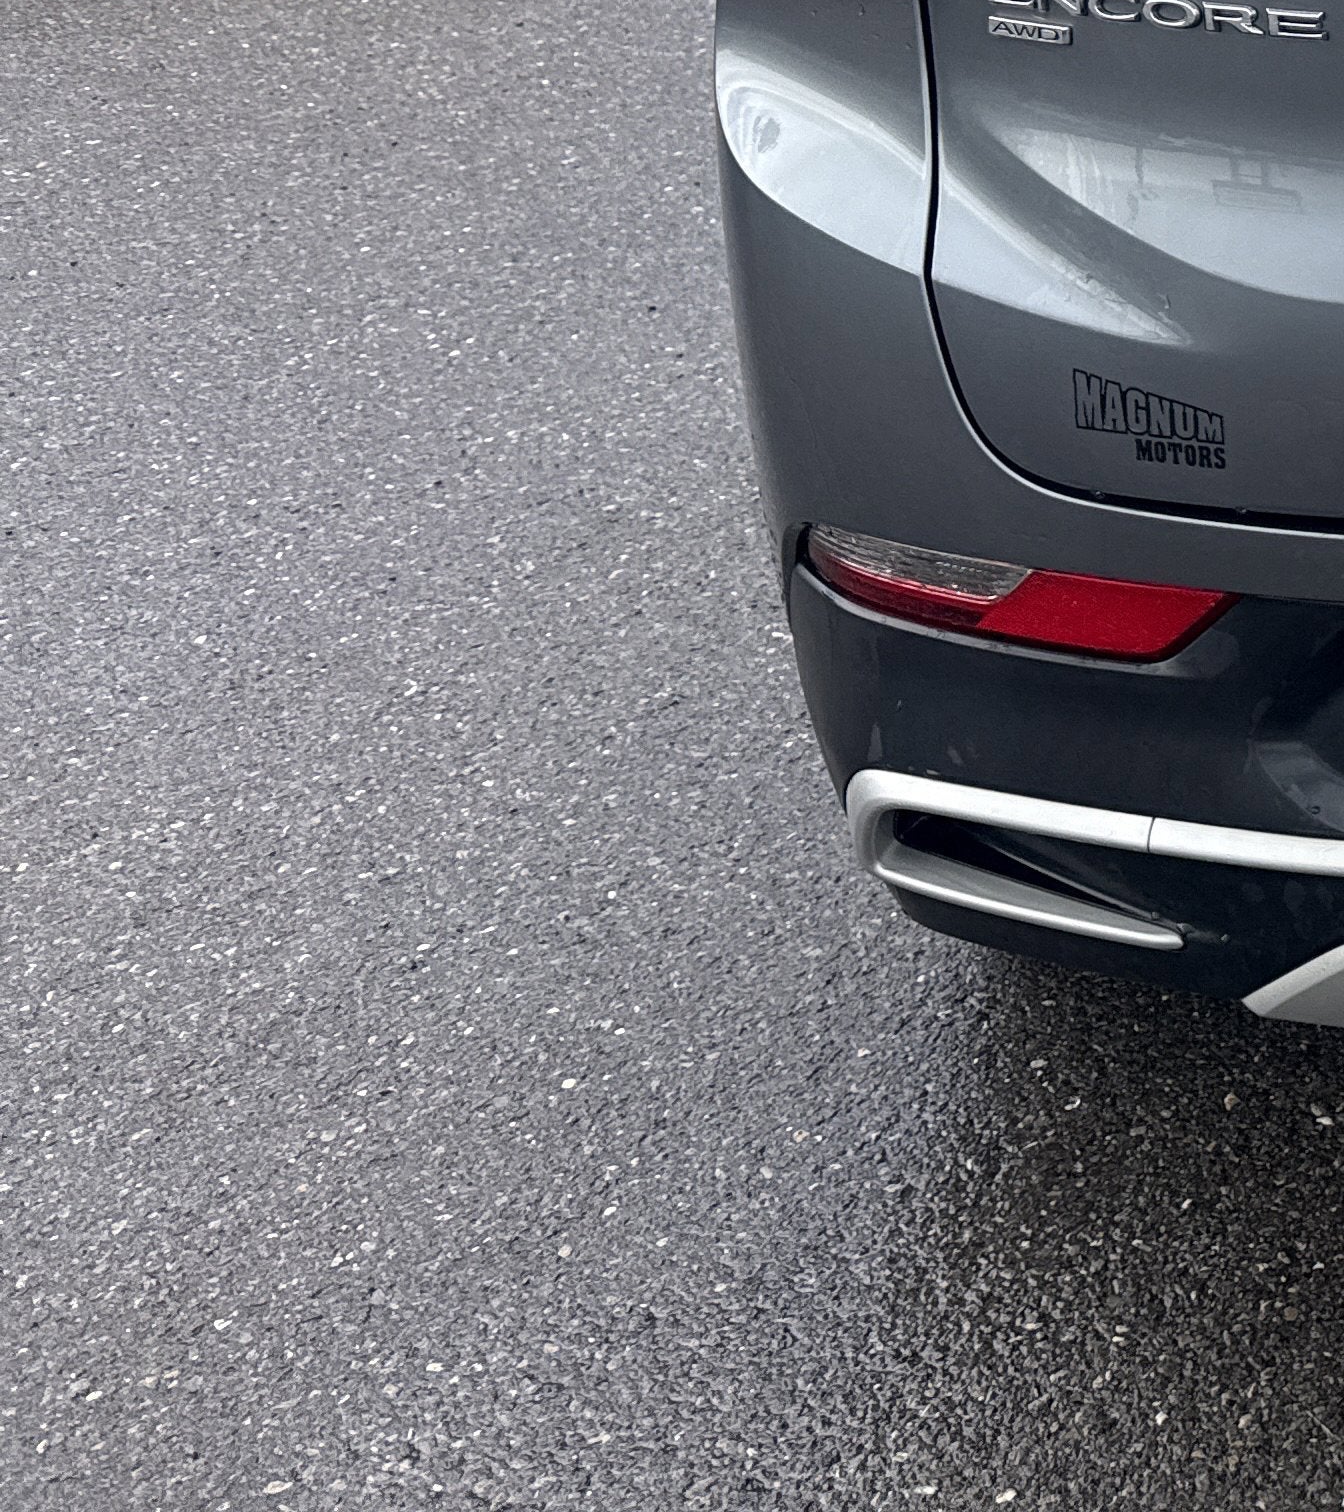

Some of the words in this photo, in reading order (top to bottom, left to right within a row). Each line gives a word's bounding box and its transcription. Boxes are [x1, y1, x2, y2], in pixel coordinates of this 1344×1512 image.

[991, 20, 1060, 41] AWD
[1072, 367, 1225, 445] MAGNUM
[1134, 438, 1227, 470] MOTORS
